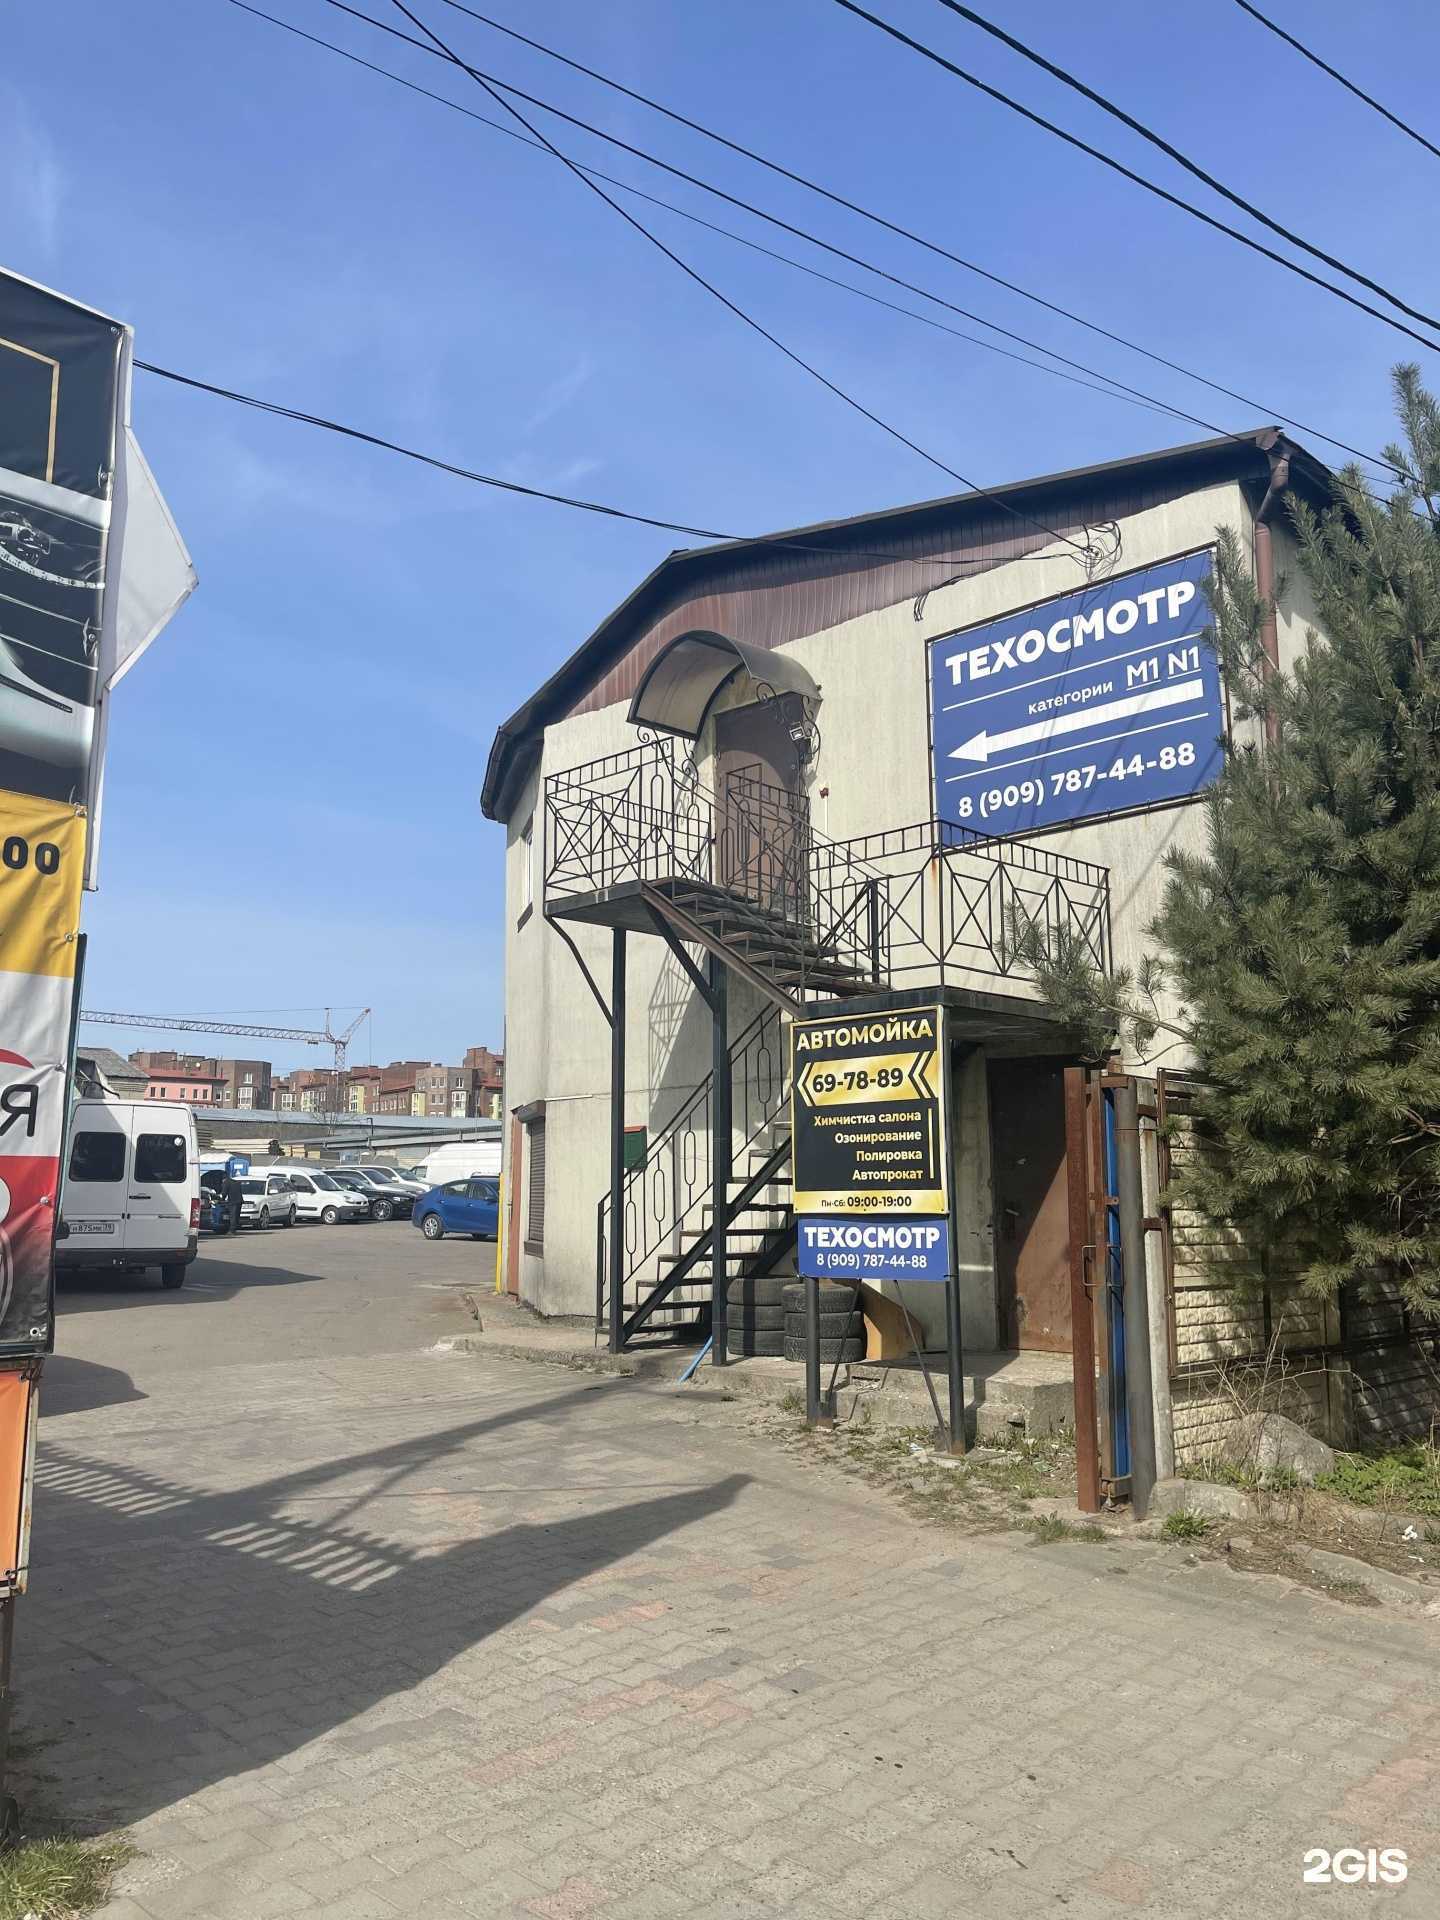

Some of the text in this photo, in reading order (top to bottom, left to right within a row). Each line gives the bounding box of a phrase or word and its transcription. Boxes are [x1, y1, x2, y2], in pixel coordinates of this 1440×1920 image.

[945, 581, 1195, 686] ТЕХОСМОТР
[1028, 646, 1200, 715] категории M1 N1
[958, 742, 1196, 818] 8 (909) 787-44-88
[797, 1017, 933, 1051] АВТОМОЙКА
[812, 1067, 904, 1093] 69-78-89
[814, 1111, 922, 1127] Химчистка салона
[834, 1131, 922, 1144] Озонирование
[856, 1149, 923, 1162] Полировка
[852, 1169, 924, 1182] Автопрокат
[821, 1196, 912, 1207] Пн-Сб: 09:00-19:00
[804, 1226, 940, 1249] ТЕХОСМОТР
[816, 1253, 928, 1269] 8 (909) 787-44-88
